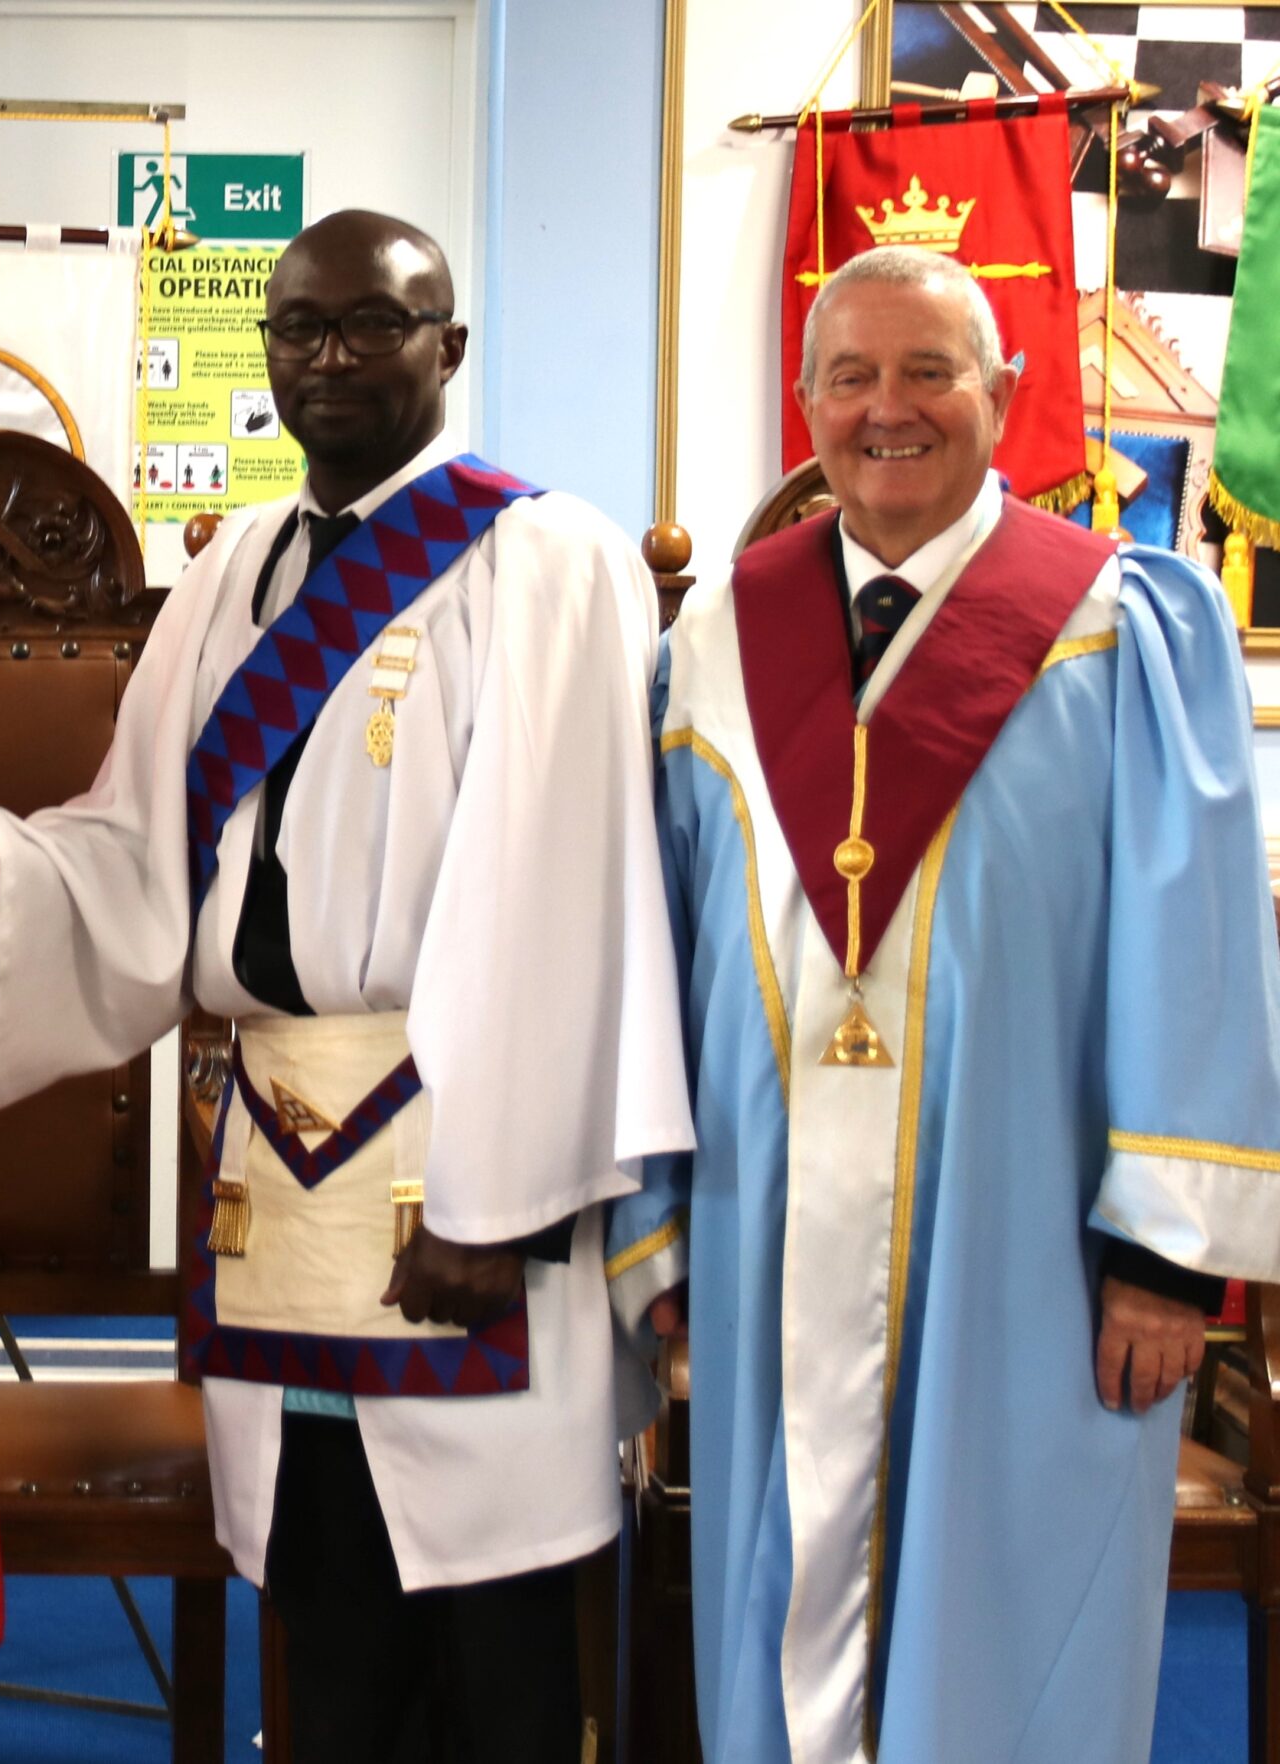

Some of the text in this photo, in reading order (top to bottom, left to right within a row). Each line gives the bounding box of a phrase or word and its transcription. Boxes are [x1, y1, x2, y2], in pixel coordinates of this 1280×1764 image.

[224, 183, 282, 212] Exit
[141, 256, 278, 273] CIAL DISTANCI
[173, 305, 212, 314] introduced
[222, 305, 242, 314] social
[187, 325, 225, 334] guidelines
[195, 350, 218, 359] Please
[221, 350, 238, 360] keep
[193, 360, 222, 369] distance
[225, 360, 233, 369] of
[247, 361, 267, 369] metr
[191, 369, 266, 378] other customers and
[147, 401, 209, 411] Wash your hands
[180, 409, 197, 418] with
[198, 411, 216, 419] soap
[157, 418, 176, 426] hand
[234, 457, 255, 465] Please
[257, 457, 274, 467] keep
[250, 465, 276, 473] markers
[146, 501, 163, 510] LERT
[171, 502, 207, 511] CONTROL
[209, 502, 222, 511] THE
